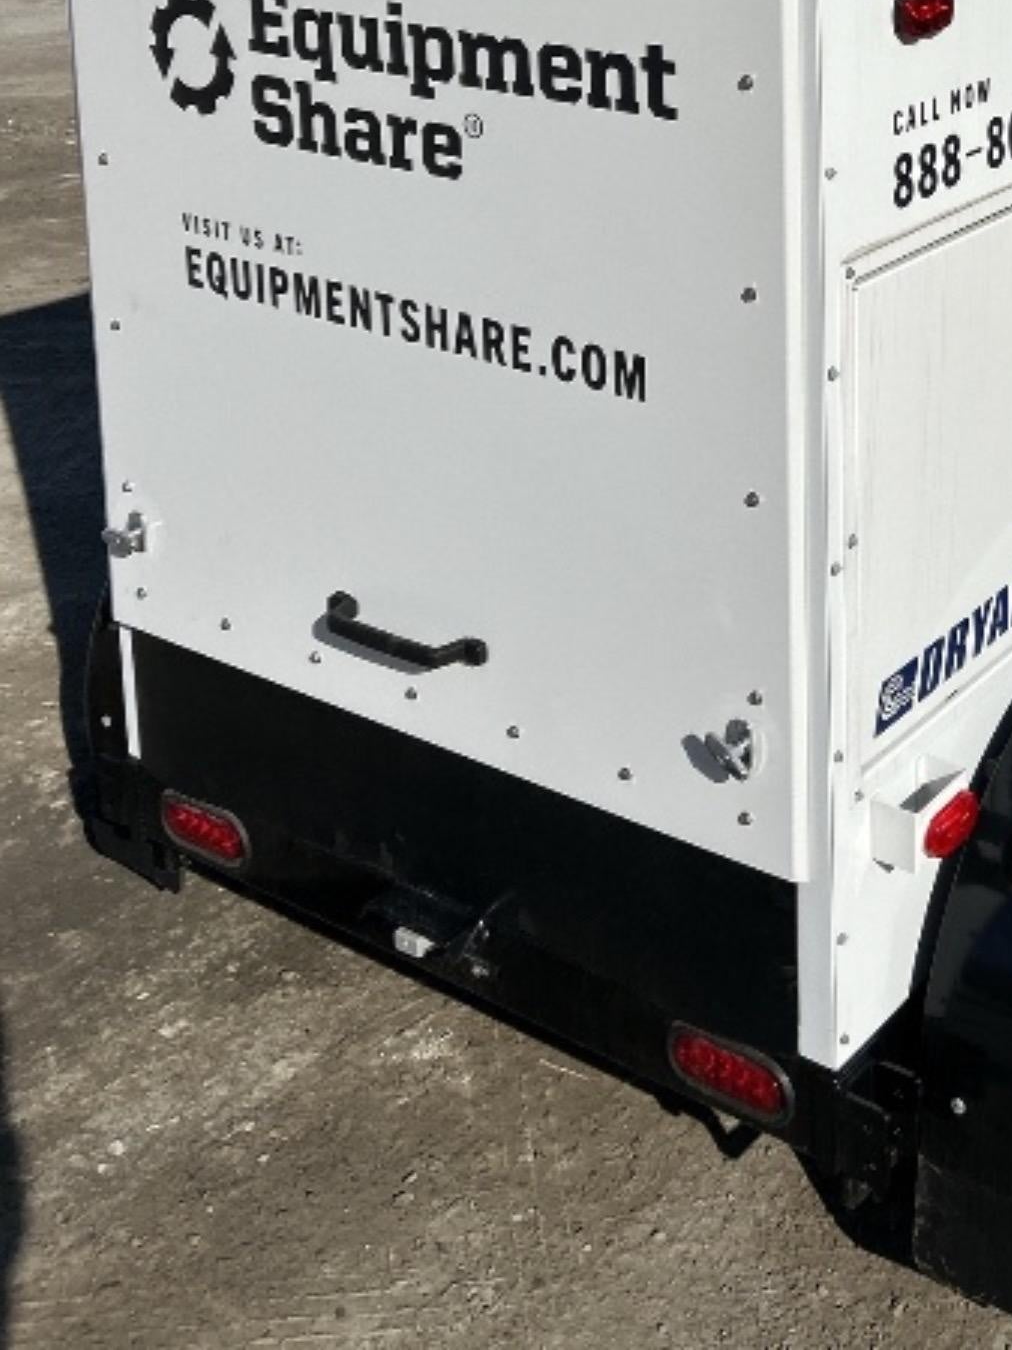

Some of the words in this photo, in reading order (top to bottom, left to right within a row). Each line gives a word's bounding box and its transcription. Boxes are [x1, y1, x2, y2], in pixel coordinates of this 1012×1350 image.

[893, 97, 940, 136] CALL
[182, 212, 231, 241] VISIT
[239, 225, 264, 249] US
[272, 233, 303, 255] AT:
[185, 246, 647, 402] EQUIPMENTSHARE.COM
